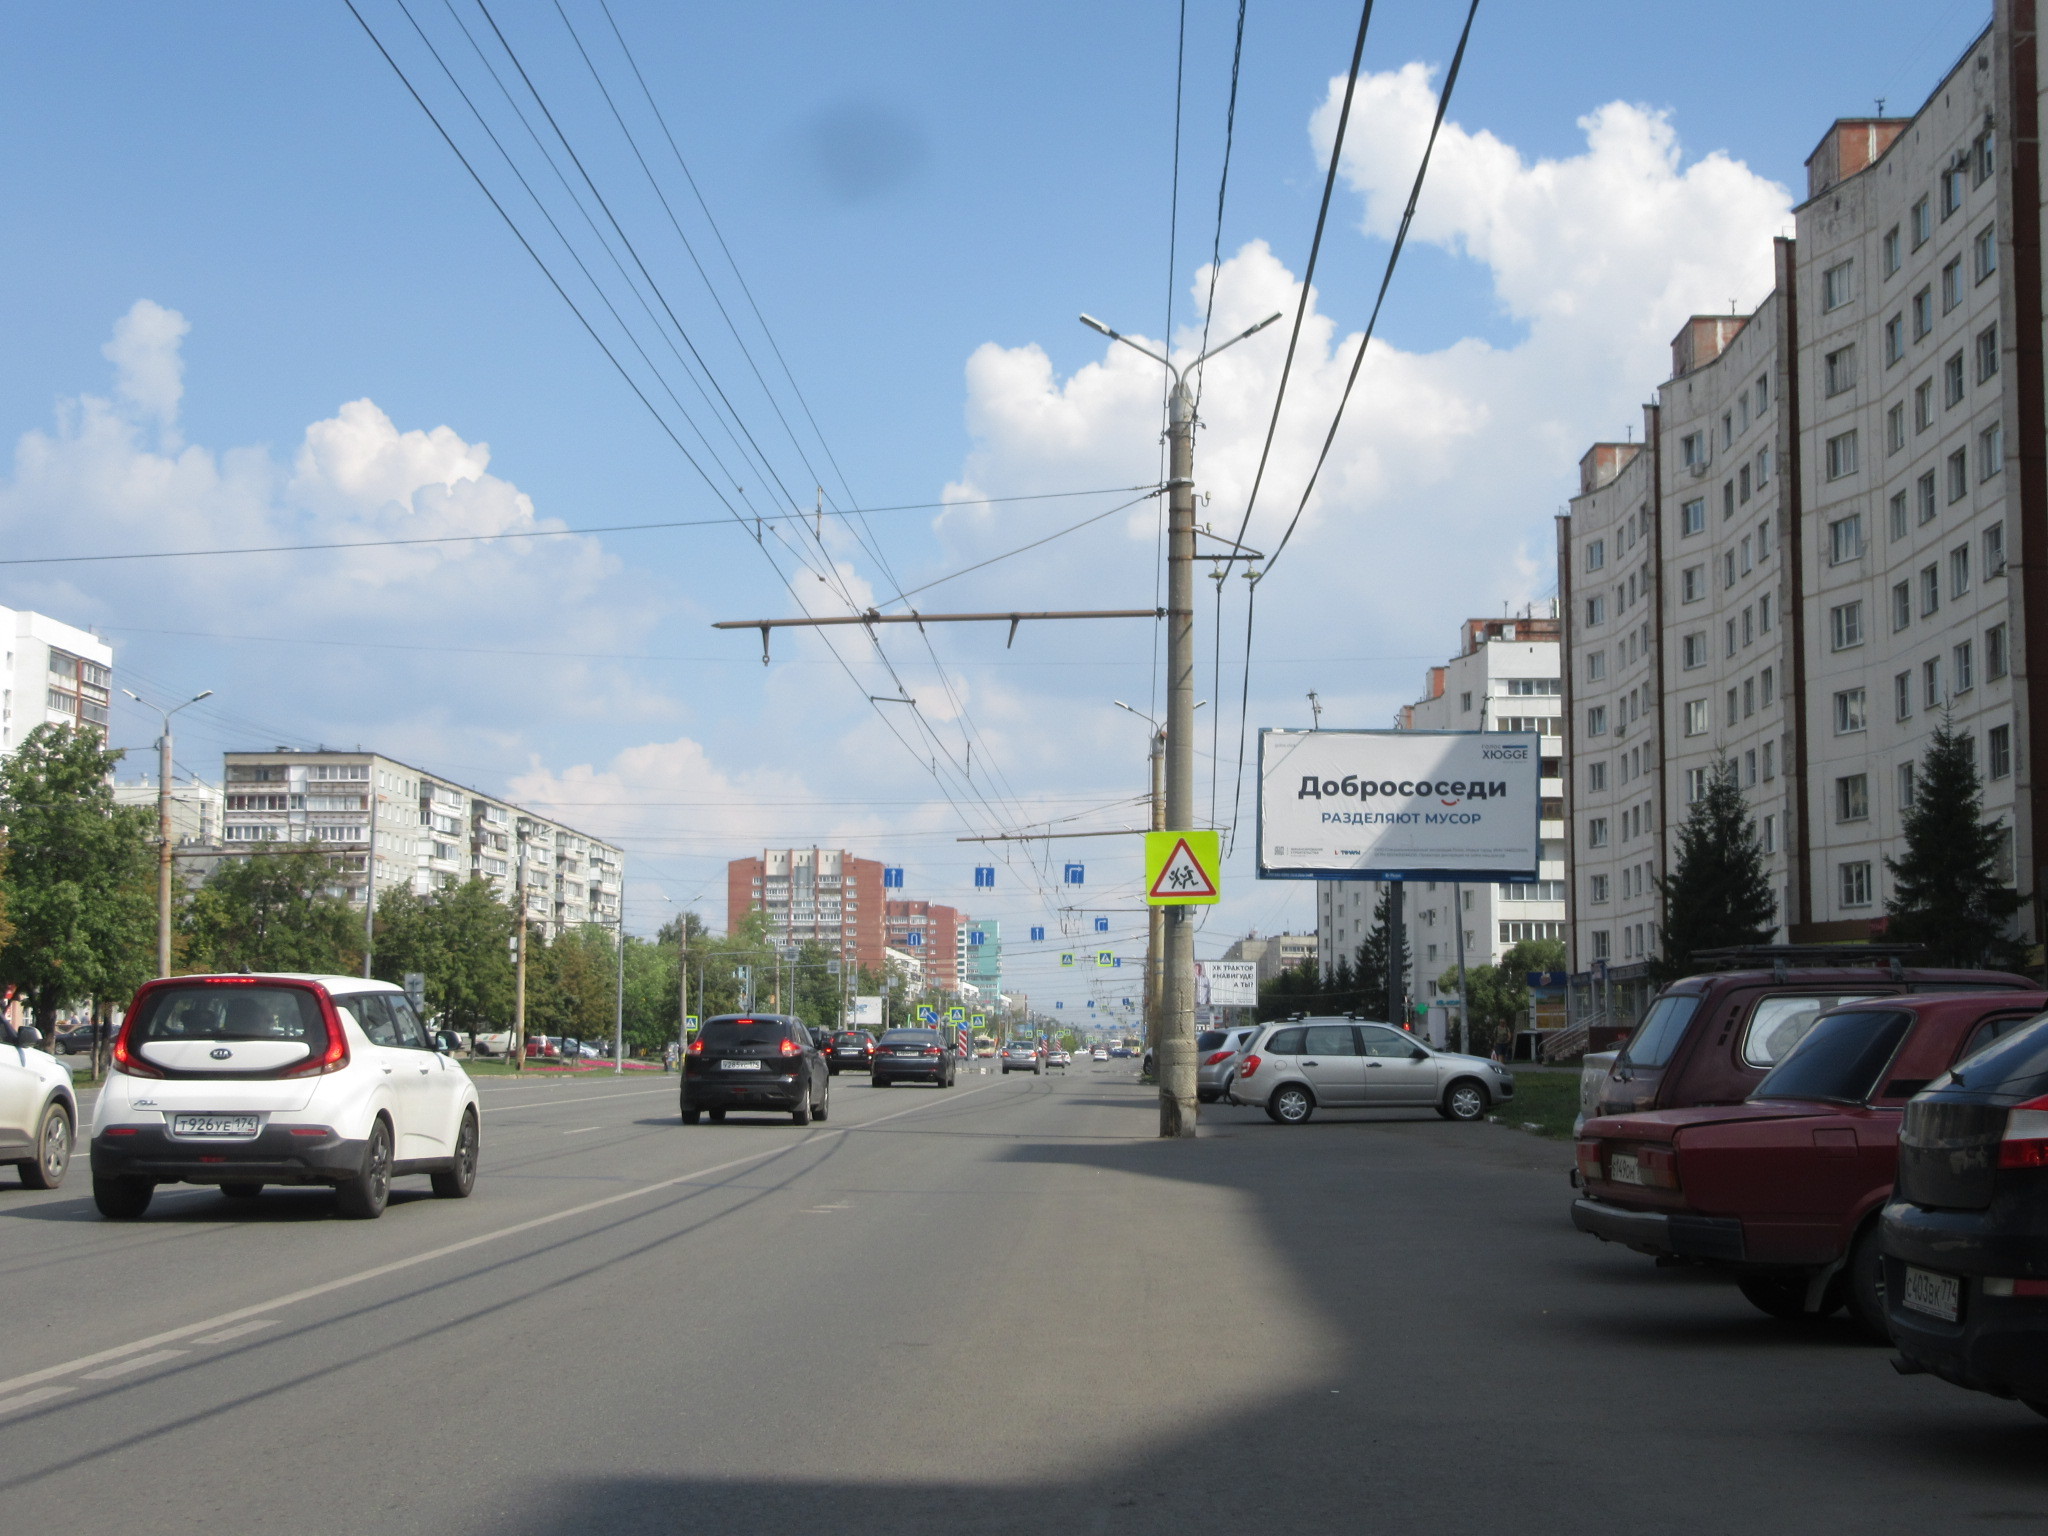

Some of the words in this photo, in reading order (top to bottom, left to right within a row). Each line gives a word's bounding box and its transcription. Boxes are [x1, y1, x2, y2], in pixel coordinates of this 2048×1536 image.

[1298, 775, 1507, 801] Добрососеди
[1321, 812, 1420, 826] РАЗДЕЛЯЮТ
[1425, 813, 1482, 825] МУСОР
